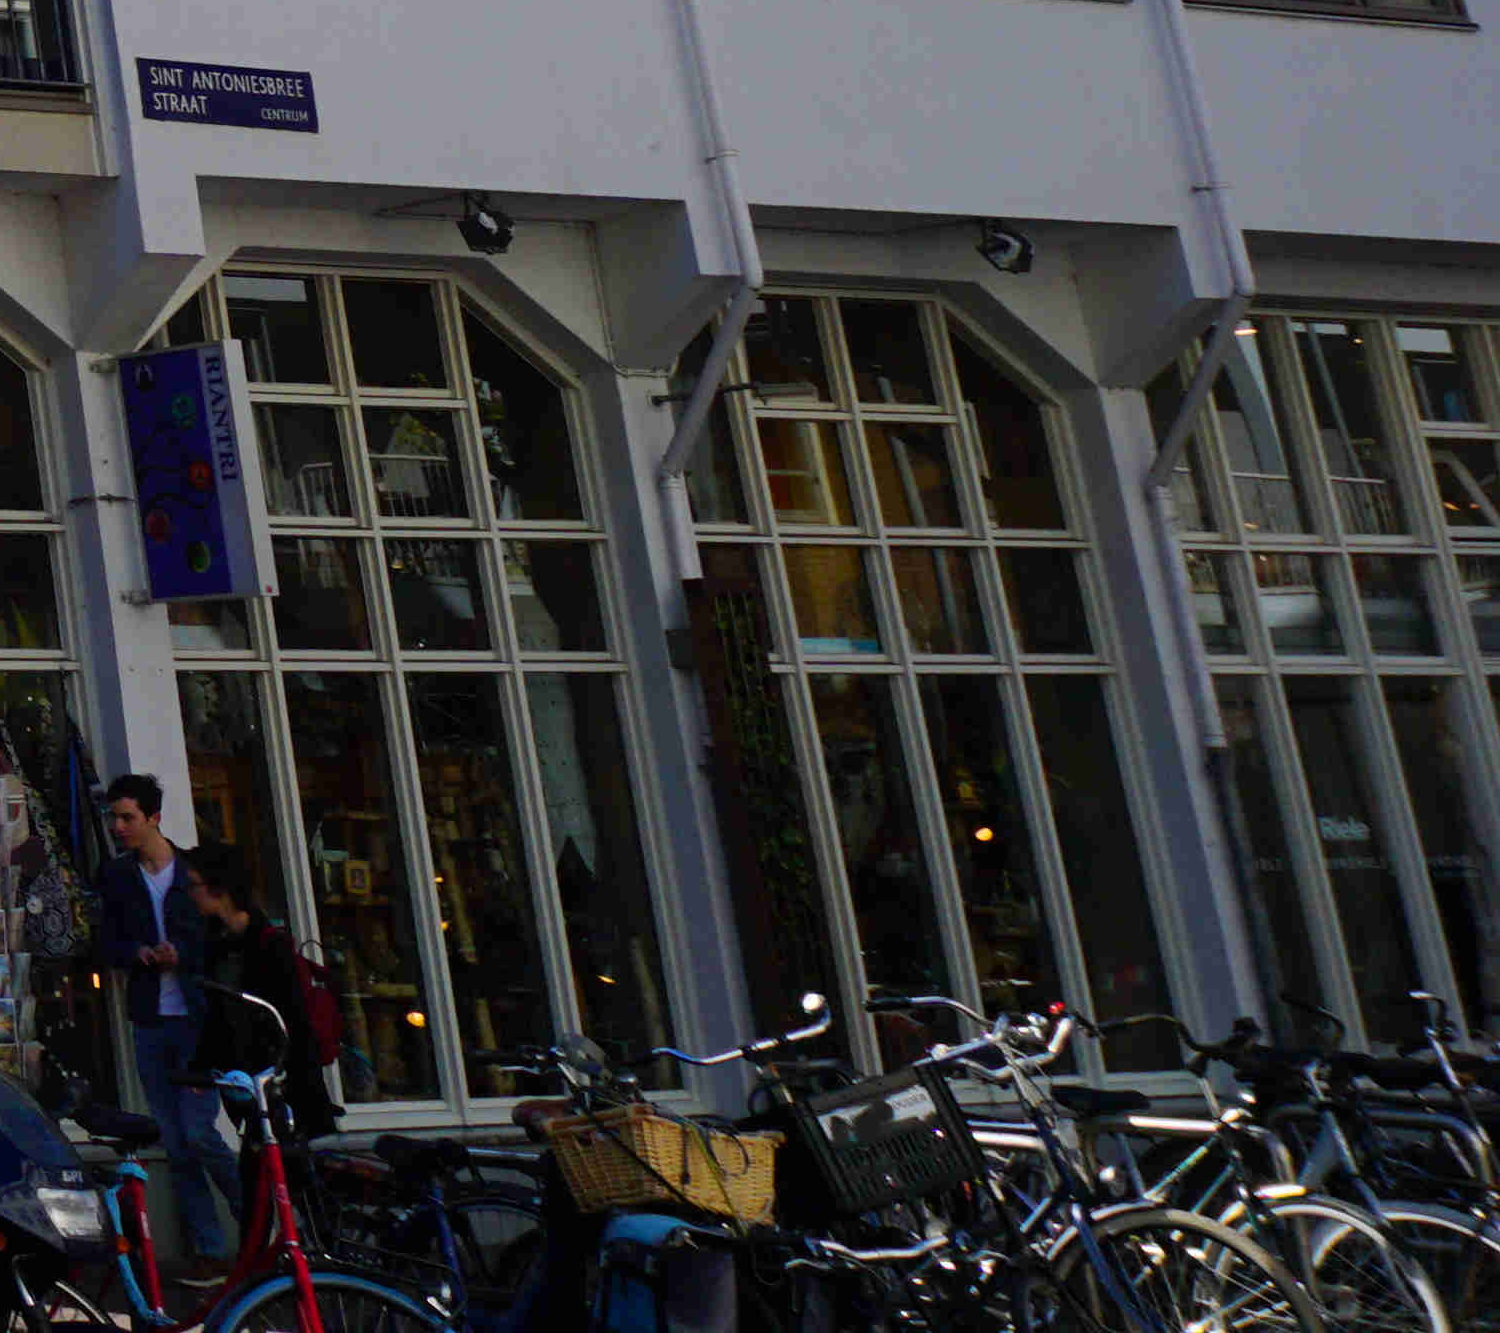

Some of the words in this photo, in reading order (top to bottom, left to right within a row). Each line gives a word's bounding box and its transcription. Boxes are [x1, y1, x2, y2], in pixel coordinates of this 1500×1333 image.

[150, 66, 183, 88] SINT
[191, 69, 305, 98] ANTONIESBREE
[153, 92, 208, 116] STRAAT
[261, 107, 309, 122] CENTRUM
[205, 356, 238, 483] RIANTRI
